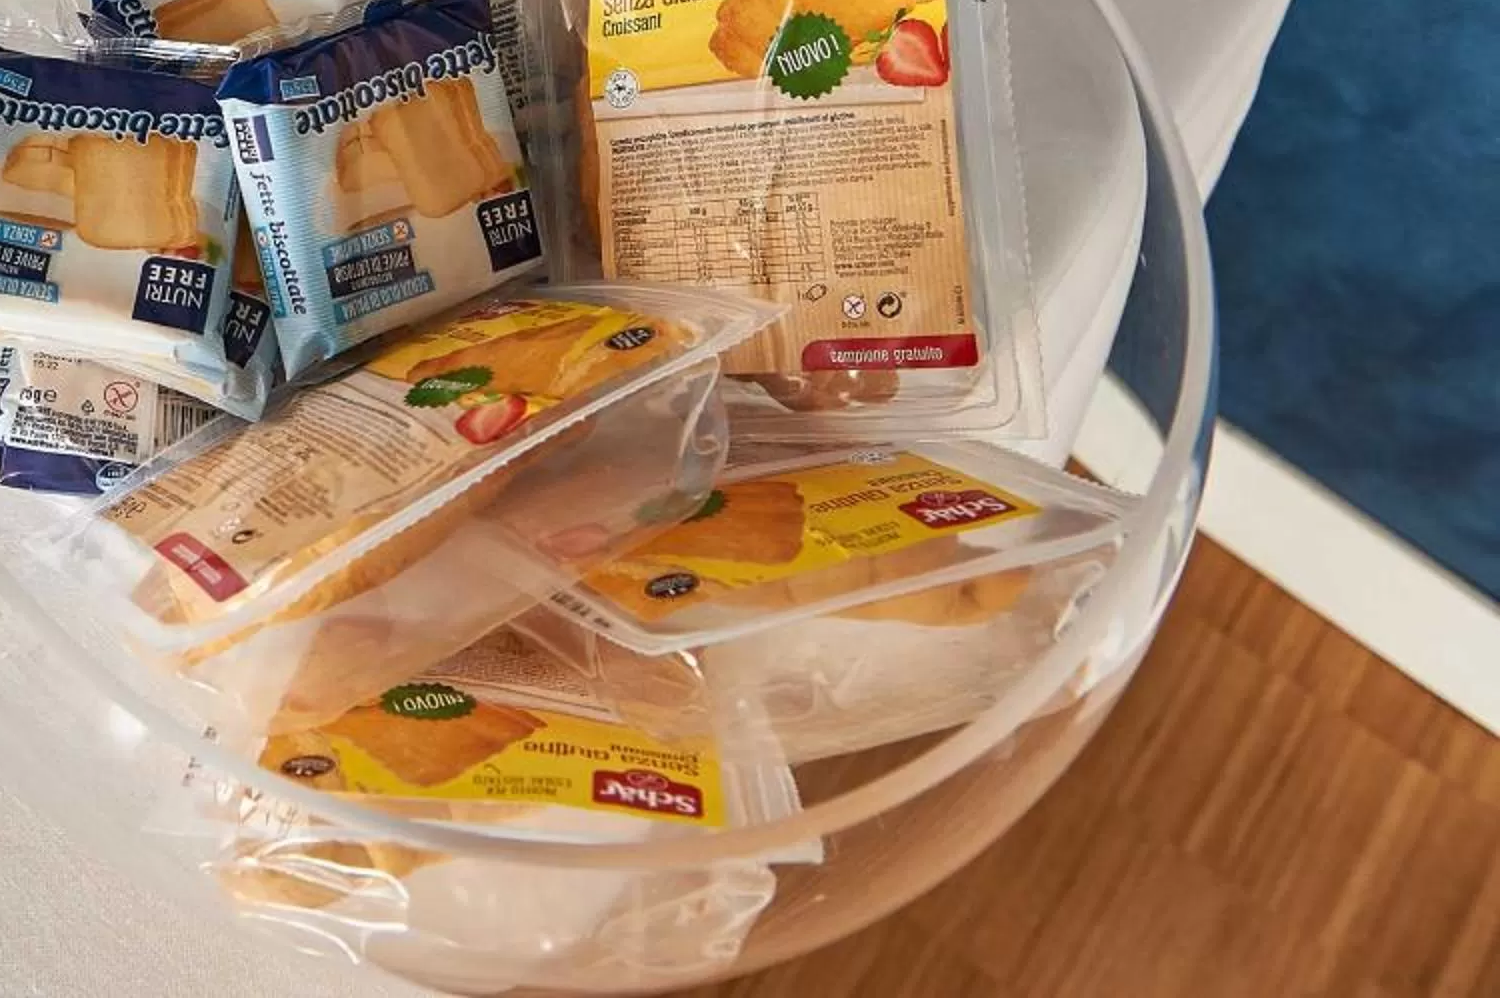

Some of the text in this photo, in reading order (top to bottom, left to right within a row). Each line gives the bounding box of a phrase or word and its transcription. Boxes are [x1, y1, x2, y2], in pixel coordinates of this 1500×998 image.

[603, 15, 662, 38] Croissant
[427, 33, 497, 78] fette
[294, 61, 425, 136] biscottate
[481, 200, 528, 228] FREE
[250, 171, 307, 315] fette biscottate
[490, 219, 532, 248] NUTRI
[149, 264, 207, 288] FREE
[145, 283, 202, 308] NUTRI
[830, 348, 888, 364] campione
[916, 497, 1006, 526] Schär
[599, 780, 696, 812] Schär
